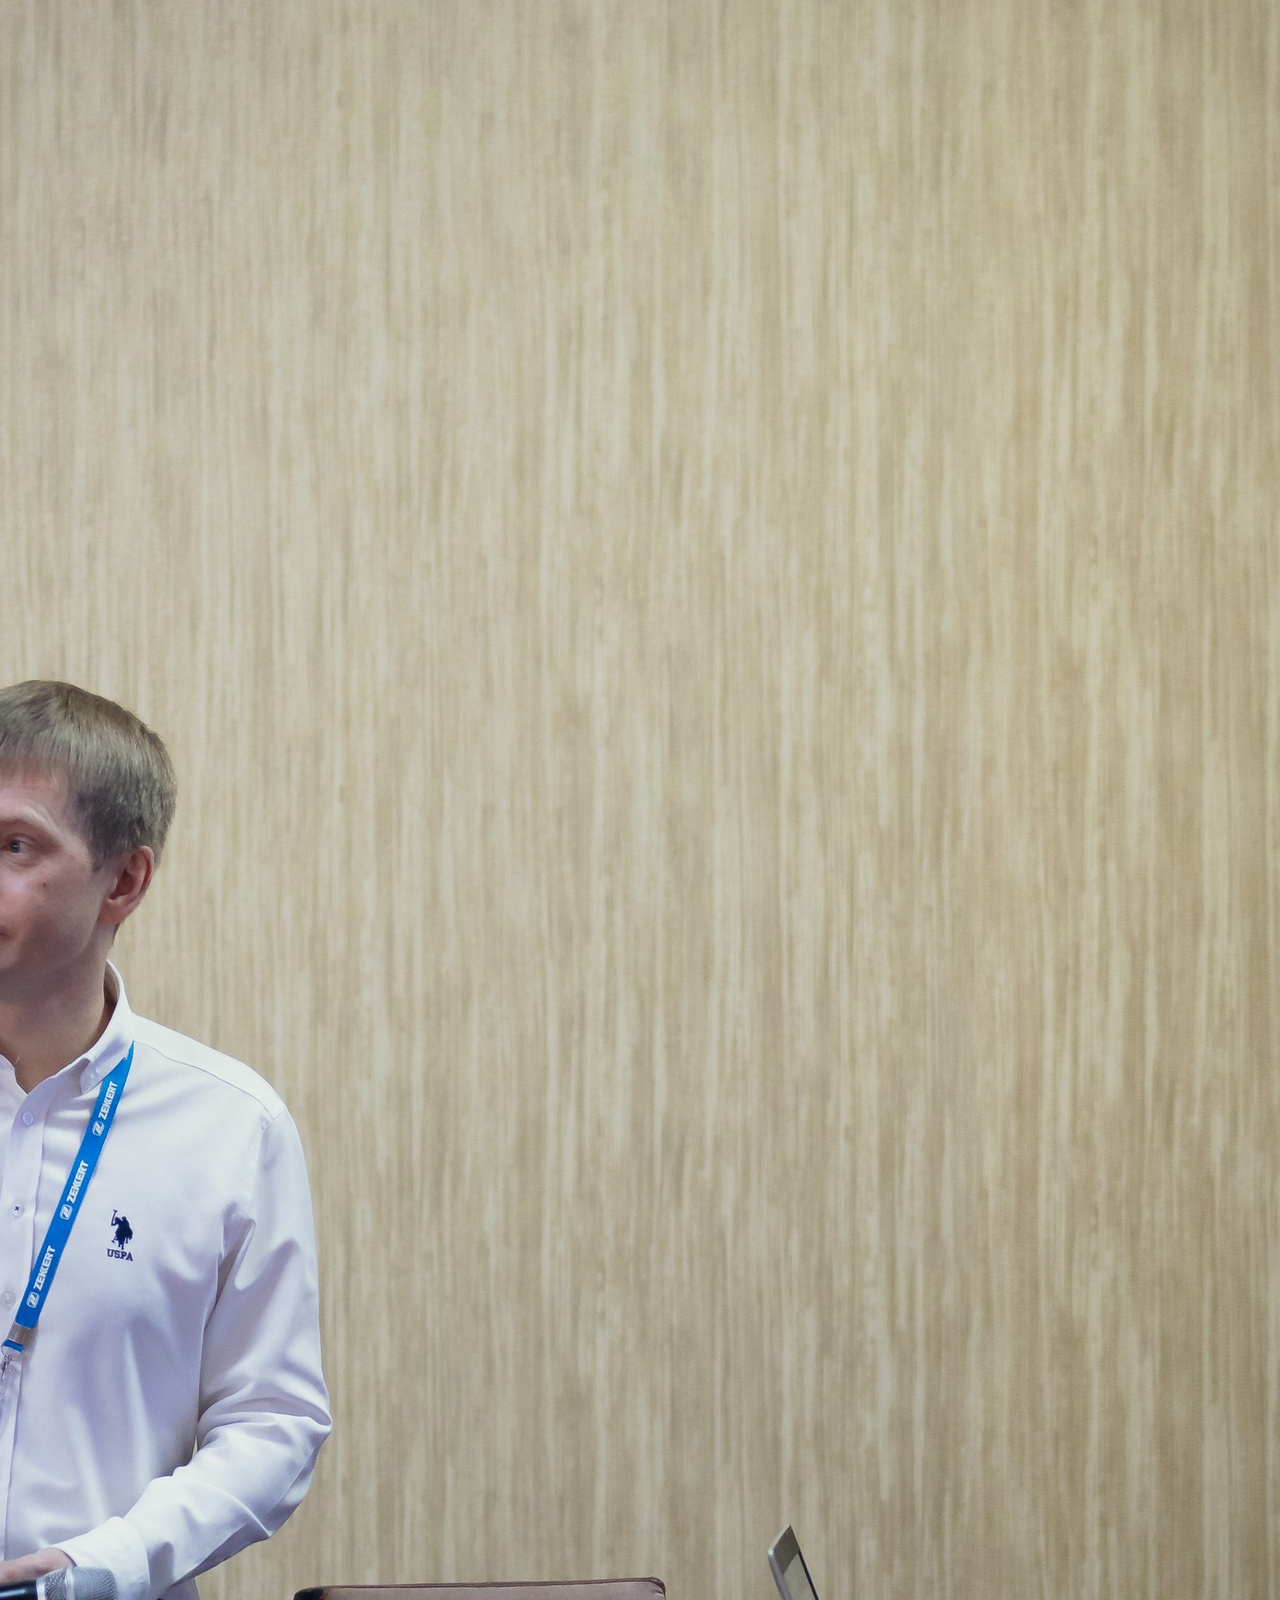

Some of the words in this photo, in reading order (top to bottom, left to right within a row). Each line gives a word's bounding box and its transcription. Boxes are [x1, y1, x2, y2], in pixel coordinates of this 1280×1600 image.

[98, 1080, 118, 1121] ZEKKERT
[66, 1160, 89, 1204] ZEKKERT
[33, 1245, 56, 1292] ZEKKERT
[107, 1248, 133, 1262] USPA
